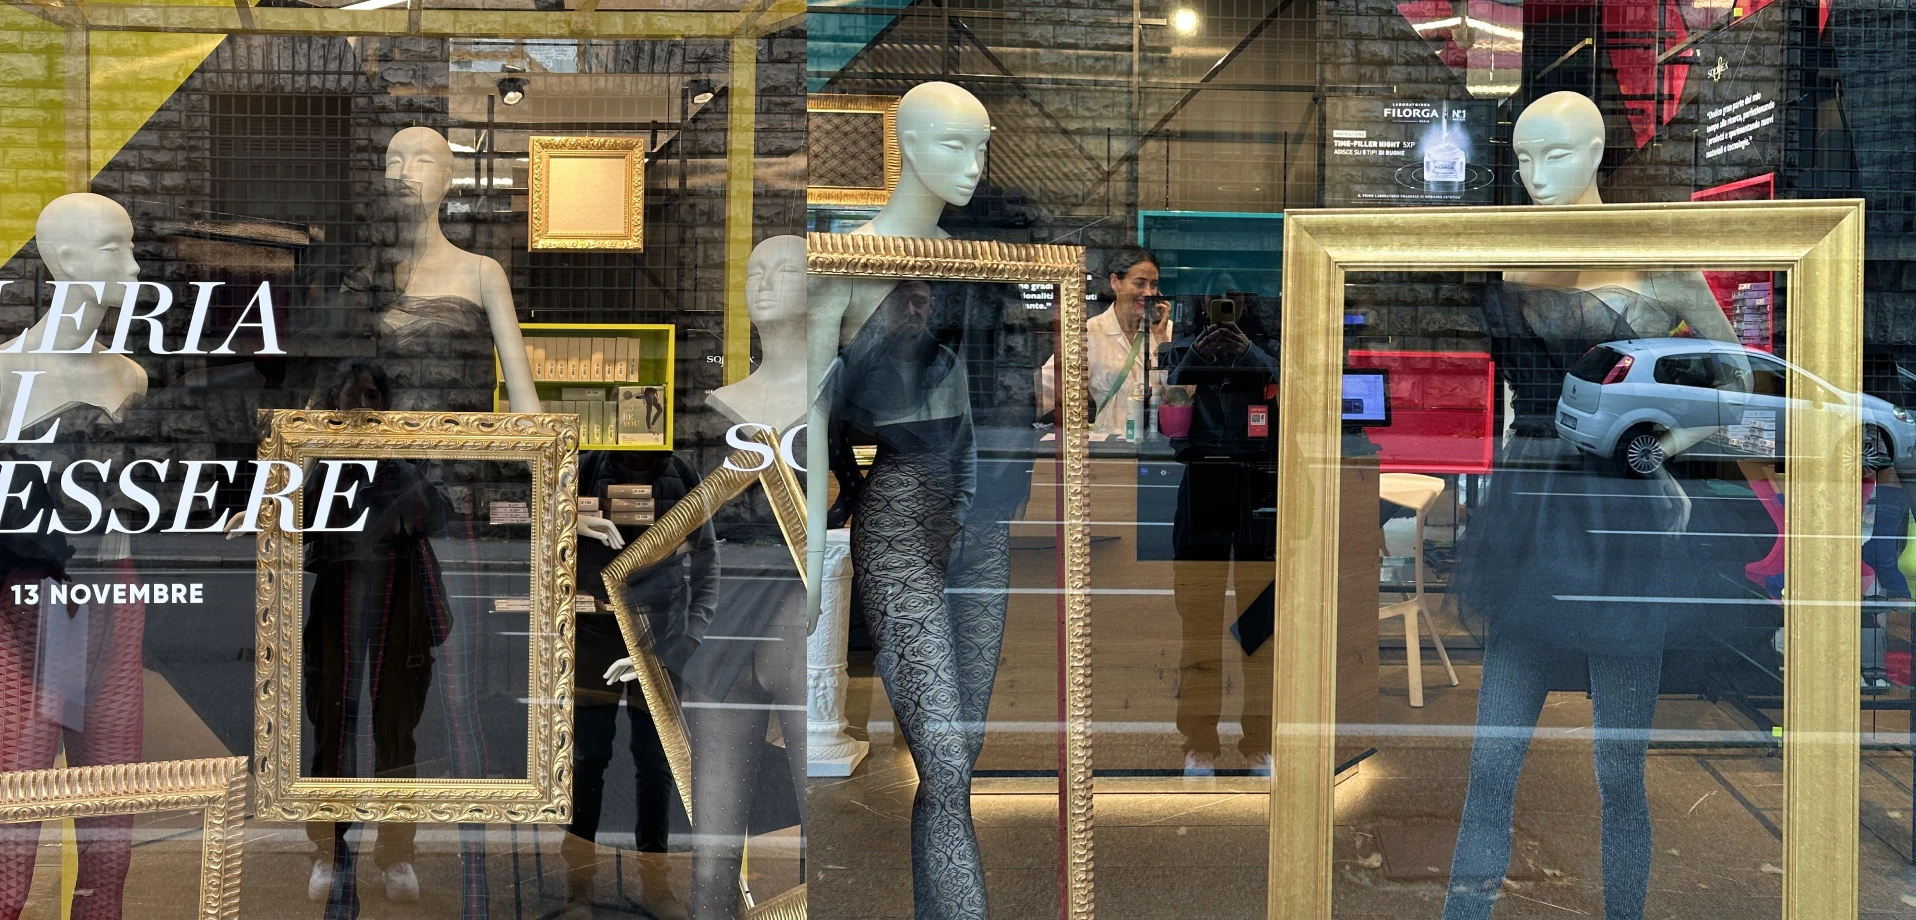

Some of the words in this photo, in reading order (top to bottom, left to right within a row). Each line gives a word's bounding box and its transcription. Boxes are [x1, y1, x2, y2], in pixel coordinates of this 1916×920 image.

[1383, 108, 1439, 118] FILORGA
[1333, 140, 1378, 148] TIME-FILLER
[1378, 141, 1400, 149] NIGHT
[0, 370, 61, 444] L
[622, 413, 634, 421] BE
[622, 420, 640, 428] YOU
[0, 459, 377, 535] ESSERE
[10, 584, 39, 605] 13
[50, 583, 204, 605] NOVEMBRE
